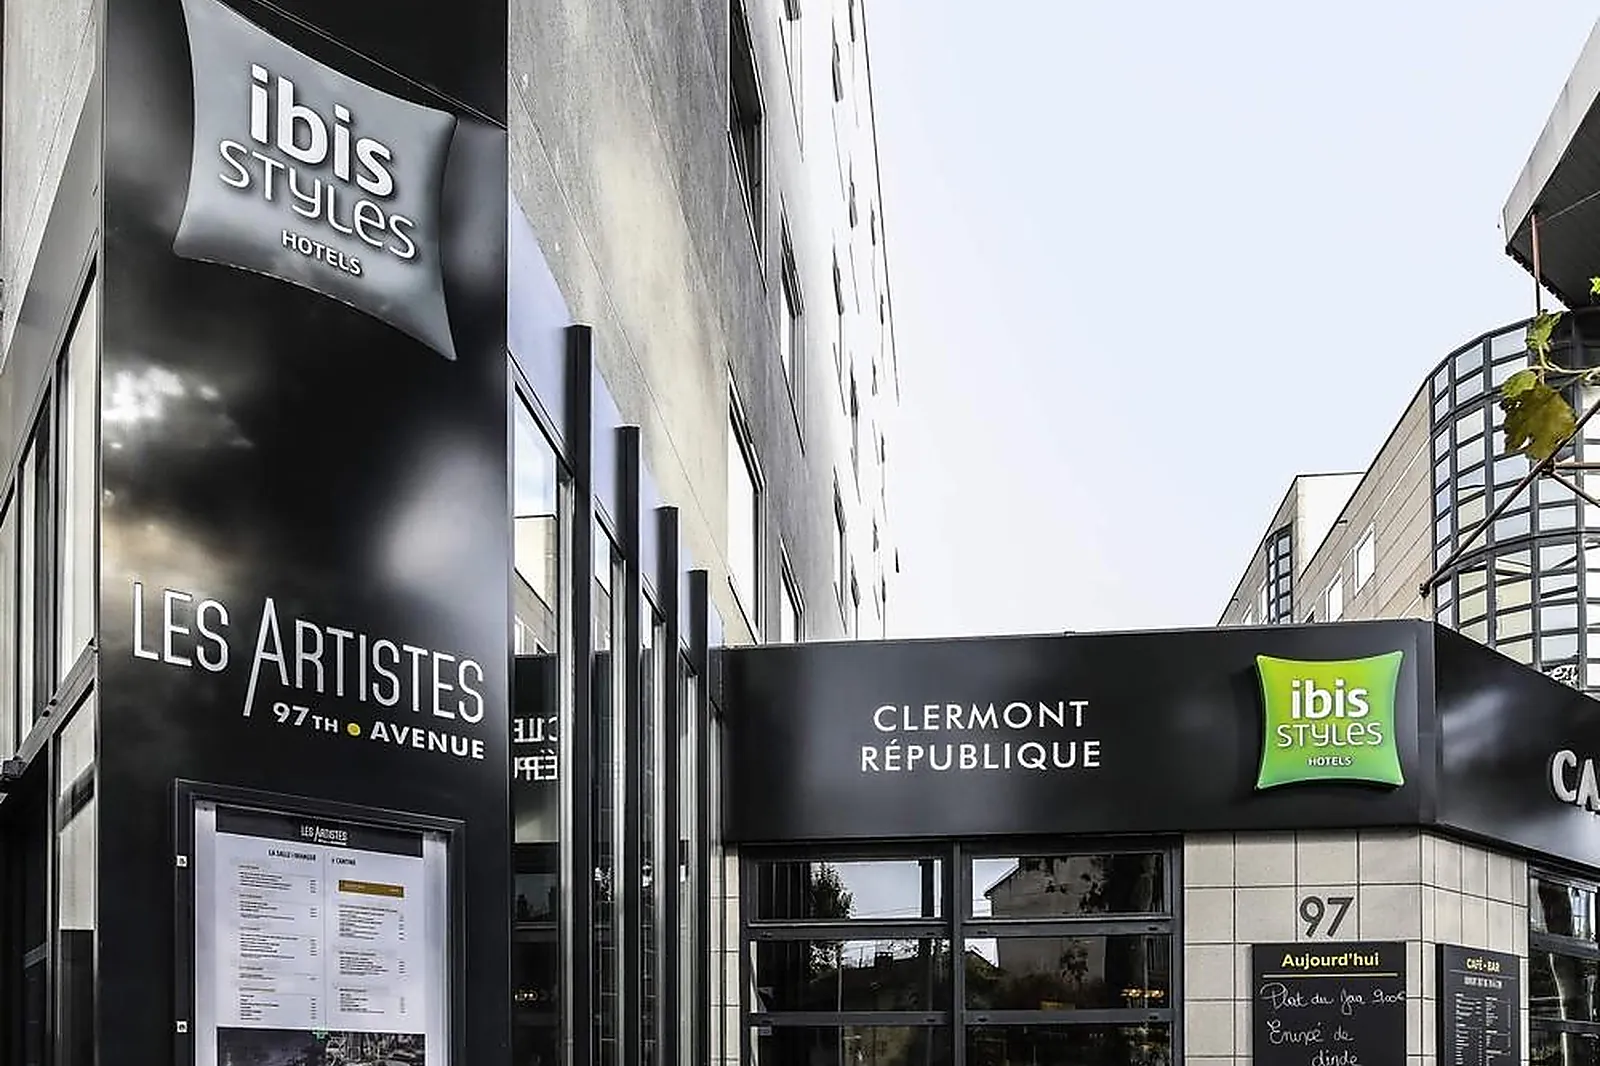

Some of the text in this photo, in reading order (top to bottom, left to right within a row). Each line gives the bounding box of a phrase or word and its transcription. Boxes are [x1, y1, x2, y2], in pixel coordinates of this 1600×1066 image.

[250, 63, 394, 197] ibis
[281, 229, 363, 276] HOTELS
[132, 582, 485, 724] LES ARTISTES
[873, 700, 1089, 732] CLERMONT
[1291, 679, 1369, 720] ibis
[272, 702, 339, 734] 97TH
[370, 721, 486, 760] AVENUE
[861, 738, 1100, 772] RÉPUBLIQUE
[1308, 755, 1352, 767] HOTELS
[1299, 895, 1355, 938] 97
[1281, 952, 1380, 971] Aujourd'hui
[1260, 982, 1307, 1010] Plat
[1311, 992, 1334, 1005] du
[1333, 1025, 1355, 1041] de
